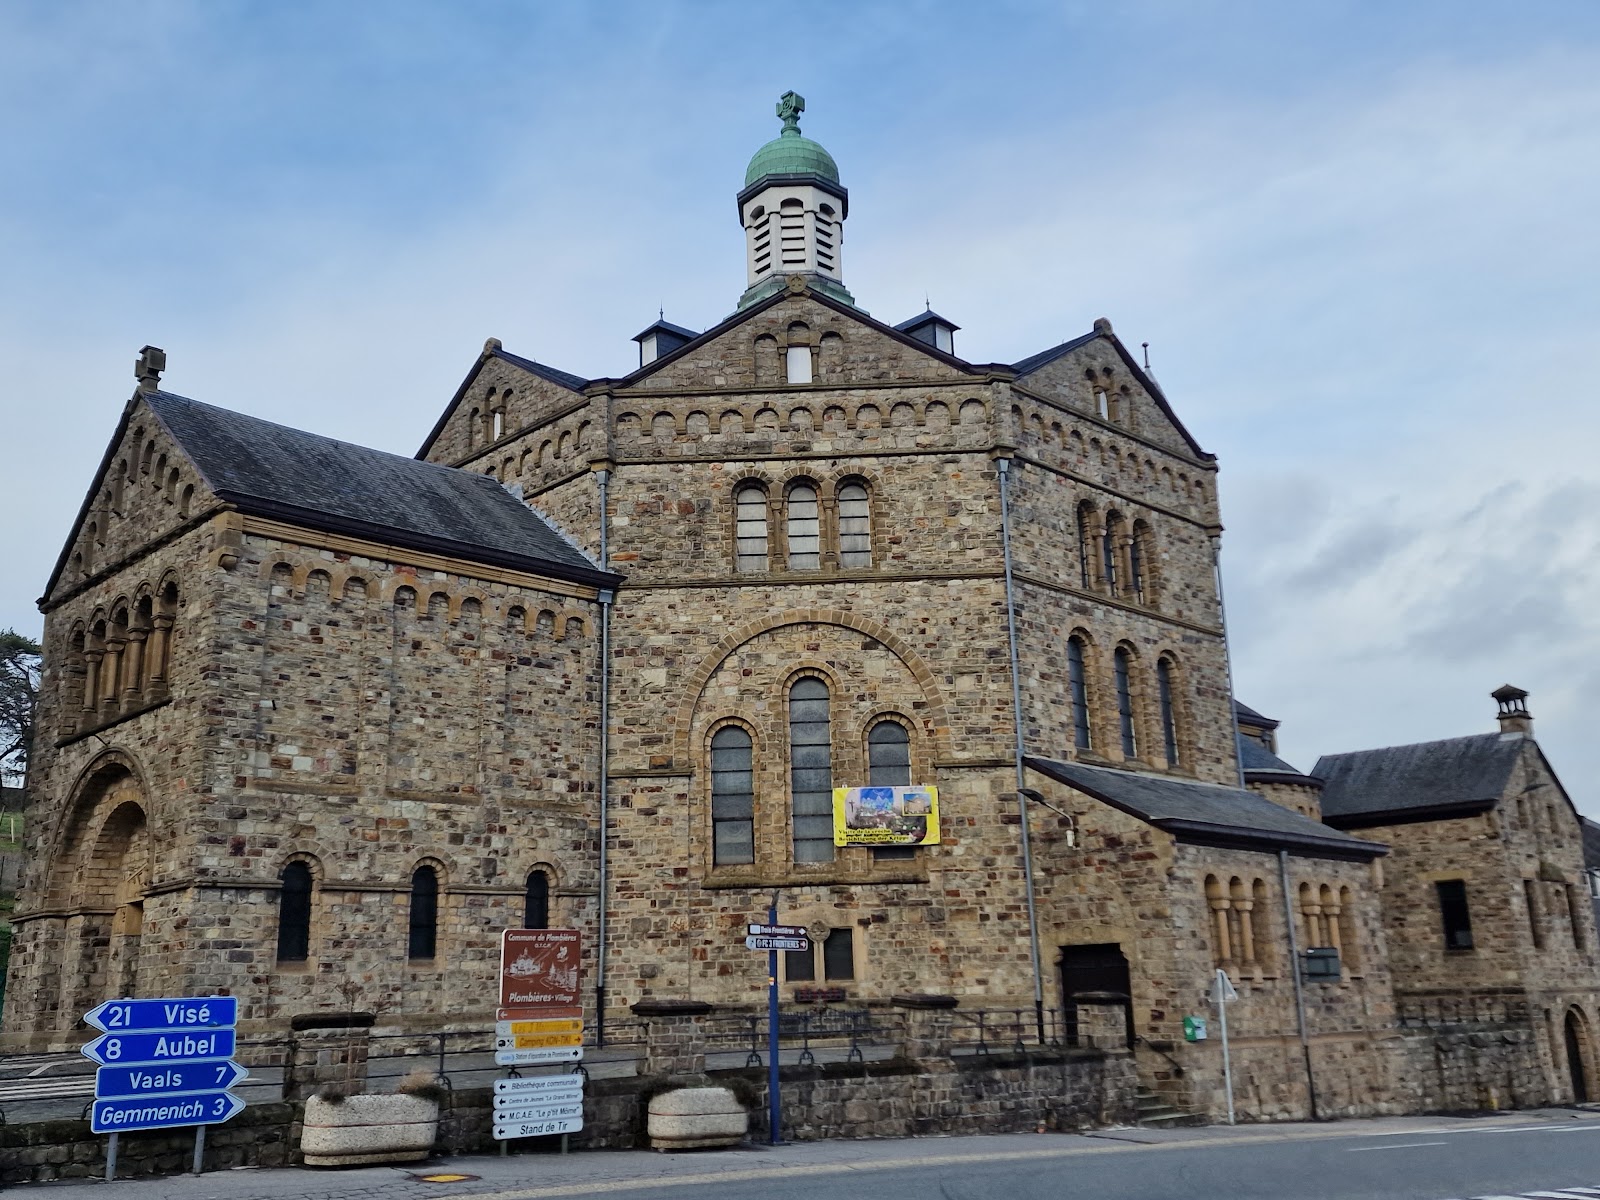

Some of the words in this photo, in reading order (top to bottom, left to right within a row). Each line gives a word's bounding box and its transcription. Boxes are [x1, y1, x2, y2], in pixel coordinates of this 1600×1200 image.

[508, 934, 536, 942] Commune
[546, 934, 577, 942] Plombières
[108, 1006, 131, 1027] 21
[164, 1004, 210, 1024] Visé
[105, 1038, 122, 1060] 8
[153, 1034, 216, 1057] Aubel
[520, 1037, 544, 1048] Camping
[129, 1070, 182, 1090] Vaals
[215, 1066, 227, 1084] 7
[511, 1082, 545, 1090] Bibliothèque
[100, 1100, 204, 1125] Gemmenich
[212, 1098, 225, 1116] 3
[535, 1110, 546, 1118] "Le
[520, 1123, 544, 1135] Stand
[545, 1121, 556, 1132] de
[558, 1121, 568, 1131] Tir
